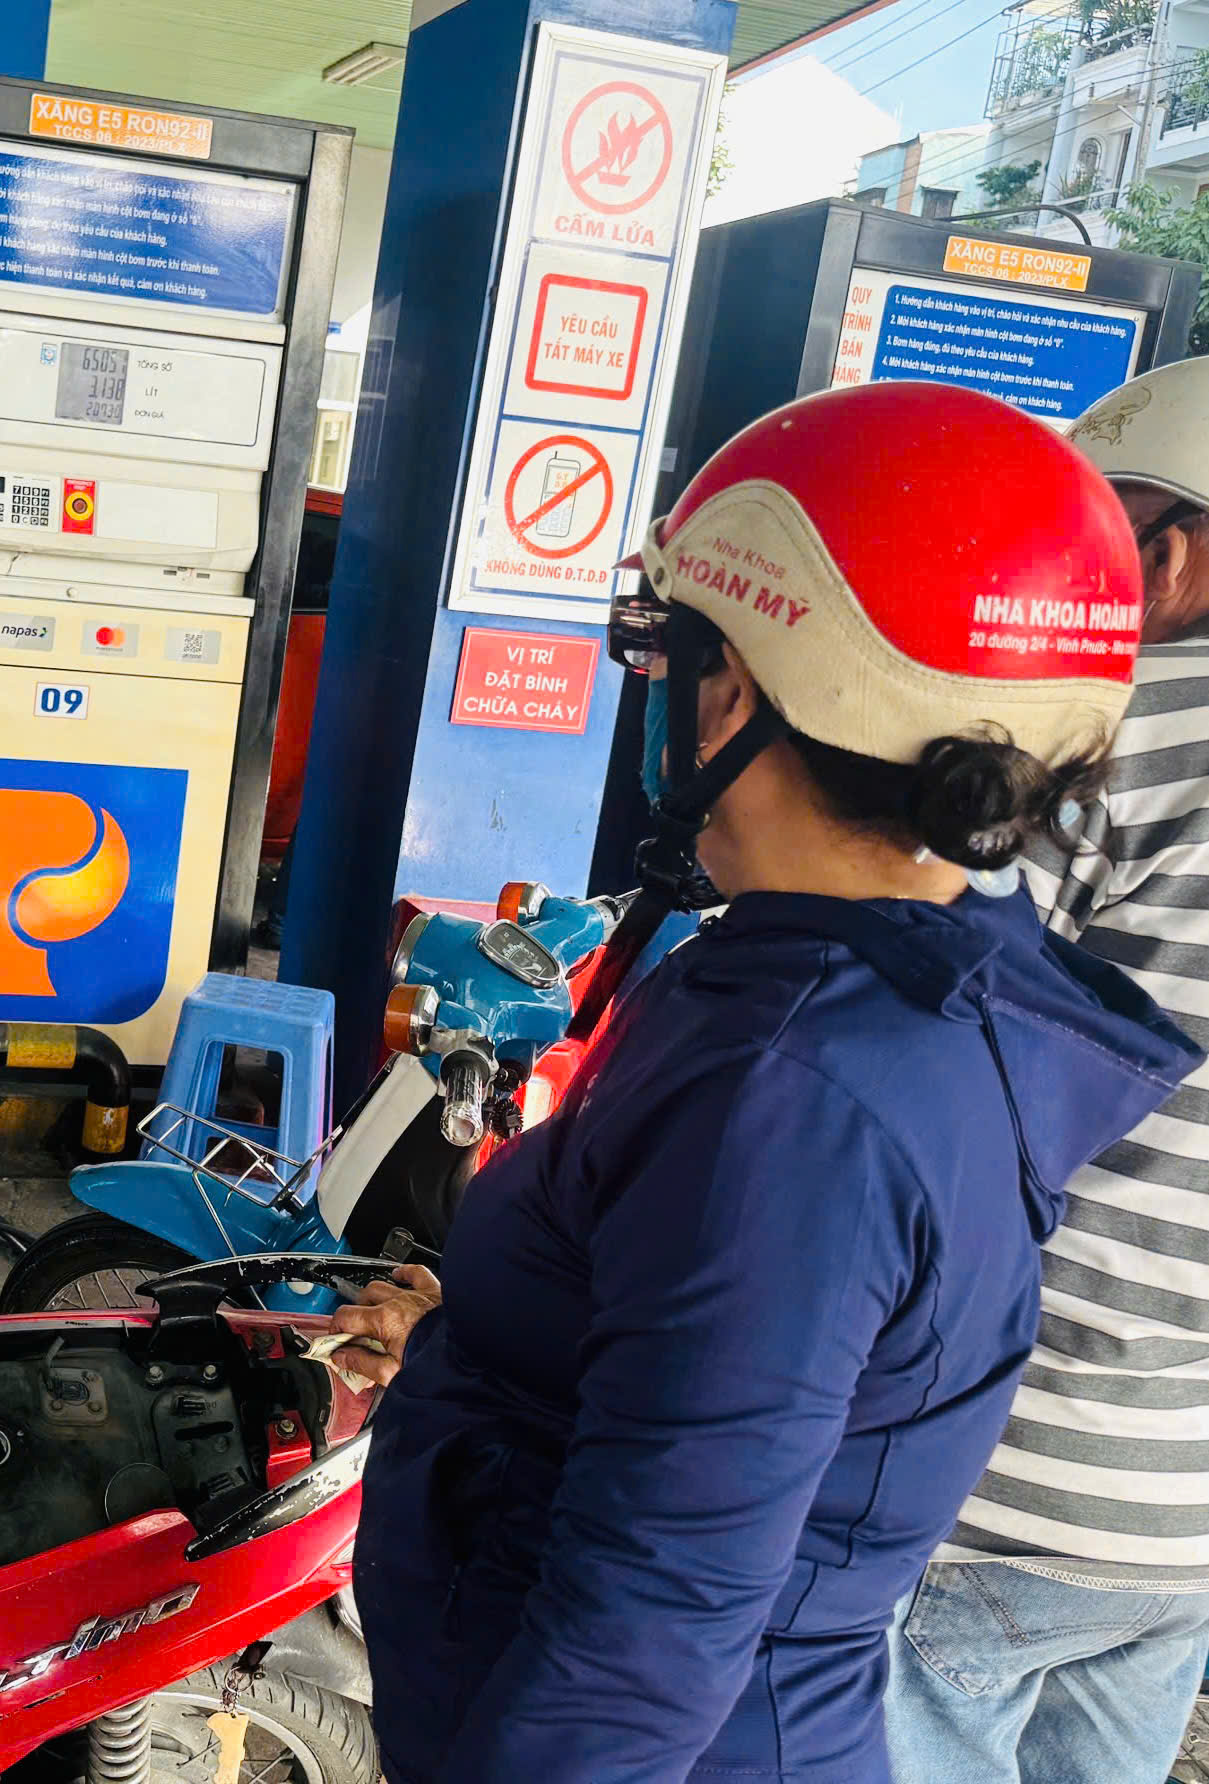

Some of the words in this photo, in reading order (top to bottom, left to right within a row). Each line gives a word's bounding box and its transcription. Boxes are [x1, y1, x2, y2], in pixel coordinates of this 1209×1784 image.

[55, 125, 90, 139] TCCS
[96, 131, 112, 143] 06
[98, 111, 121, 129] E5
[127, 115, 207, 140] RON92-II
[124, 228, 146, 242] khách
[554, 211, 604, 240] CẤM
[612, 221, 656, 247] LỬA
[3, 236, 26, 250] khách
[168, 258, 180, 271] khi
[181, 260, 201, 273] thanh
[1000, 251, 1019, 267] E5
[1023, 254, 1086, 277] RON92-II
[23, 262, 44, 276] thanh
[164, 281, 187, 295] khách
[963, 262, 993, 278] TCCS
[851, 286, 872, 306] QUY
[561, 313, 587, 335] YÊU
[843, 310, 872, 332] TRÌNH
[909, 316, 928, 329] khách
[928, 319, 944, 333] hàng
[944, 322, 955, 333] xác
[955, 323, 971, 337] nhận
[998, 329, 1009, 342] cột
[935, 299, 953, 312] khách
[954, 302, 969, 316] hàng
[970, 304, 981, 316] vào
[1041, 315, 1057, 329] nhận
[1092, 322, 1110, 335] khách
[574, 343, 604, 365] MÁY
[607, 351, 624, 368] XE
[840, 336, 863, 358] BÁN
[893, 335, 908, 348] Bơm
[908, 337, 924, 352] hàng
[951, 343, 965, 356] theo
[999, 350, 1017, 363] khách
[902, 357, 920, 370] khách
[920, 360, 935, 374] hàng
[935, 363, 947, 374] xác
[947, 364, 962, 378] nhận
[990, 370, 1001, 383] cột
[1032, 375, 1042, 387] khi
[1042, 377, 1060, 390] thanh
[86, 401, 122, 419] 20730
[1027, 395, 1046, 408] khách
[529, 560, 562, 579] DÙNG
[713, 537, 741, 559] Nha
[743, 549, 787, 579] Khoa
[676, 551, 751, 603] HOÀN
[974, 595, 1024, 625] NHA
[1029, 599, 1086, 630] KHOA
[1089, 597, 1128, 631] HOÀN
[1, 624, 38, 639] napas
[969, 632, 986, 647] 20
[1030, 636, 1048, 652] 2/4
[507, 647, 524, 665] VỊ
[530, 645, 555, 665] TRÍ
[485, 670, 520, 693] ĐẶT
[527, 672, 568, 693] BÌNH
[40, 687, 83, 714] 09
[464, 694, 518, 717] CHỮA
[523, 699, 579, 720] CHÁY
